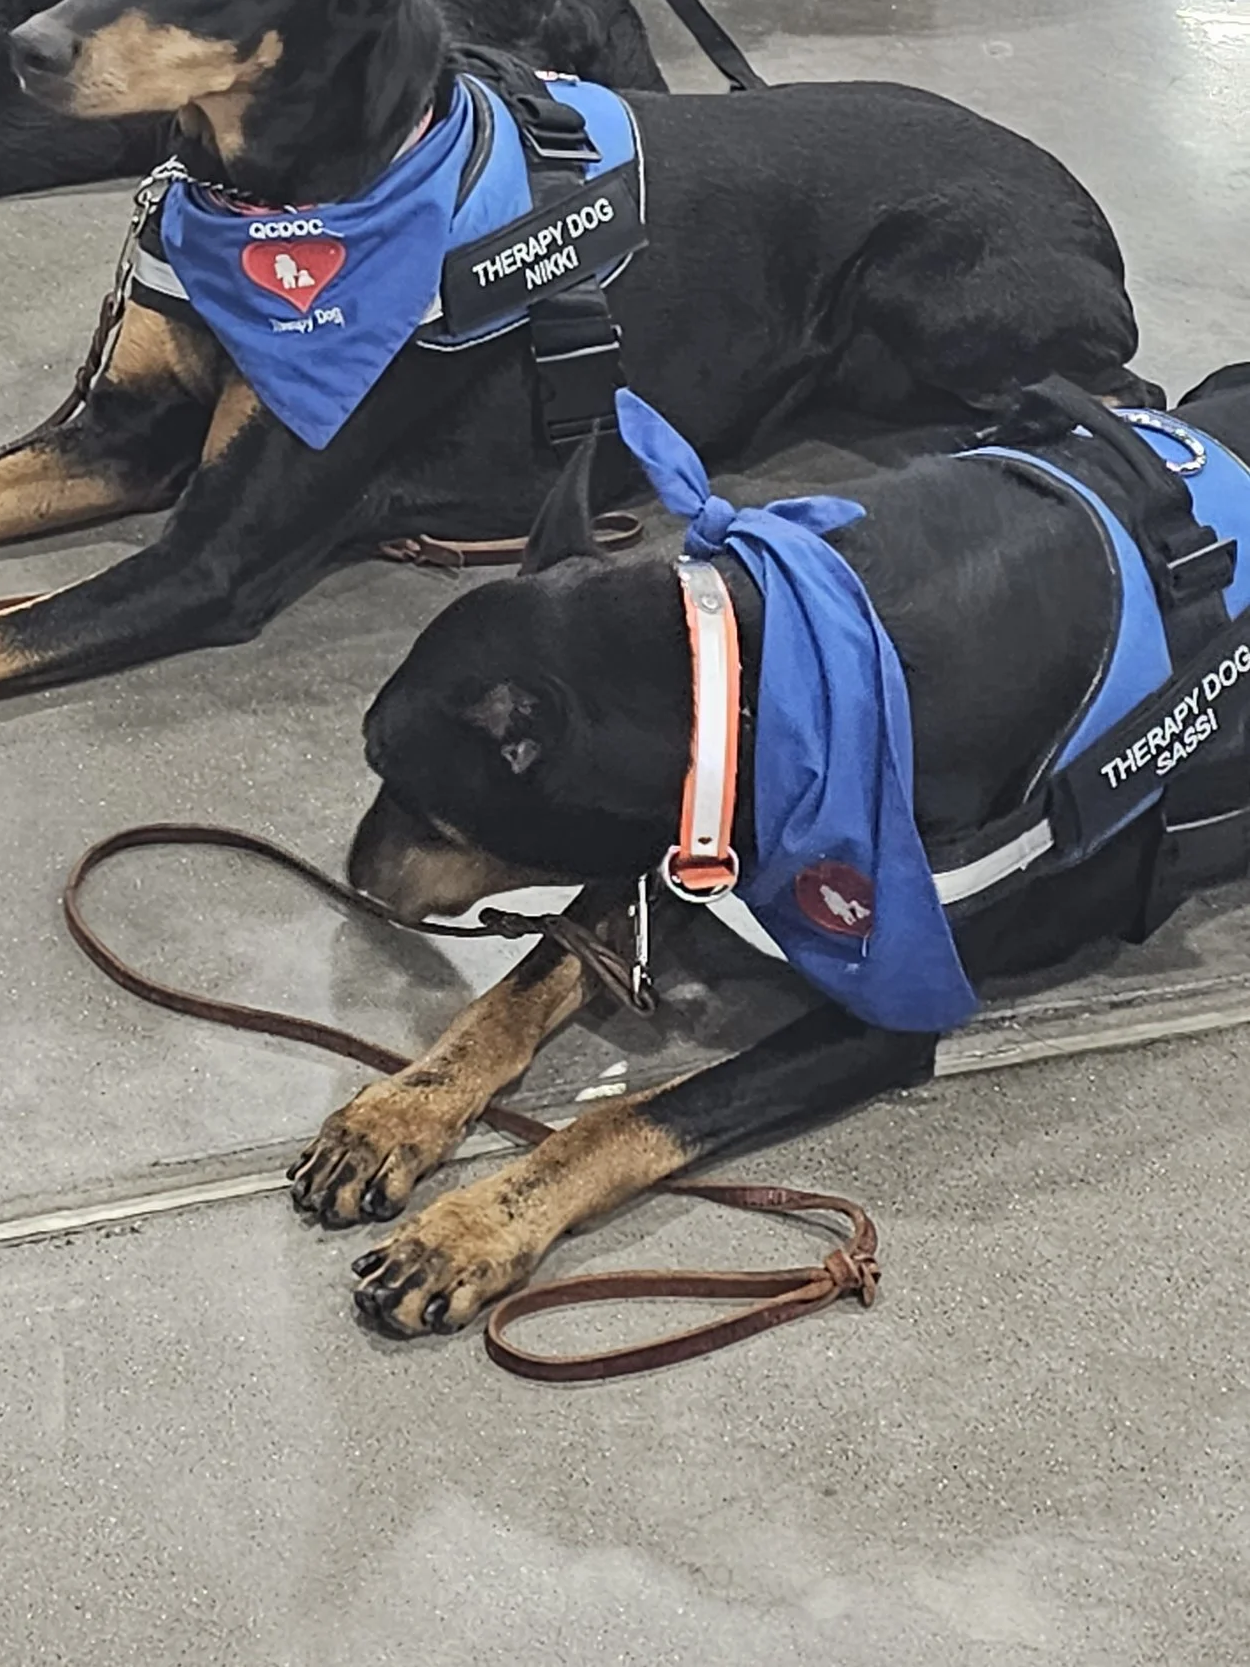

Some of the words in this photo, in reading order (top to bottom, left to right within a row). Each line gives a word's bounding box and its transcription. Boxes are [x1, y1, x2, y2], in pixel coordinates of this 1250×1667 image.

[249, 218, 324, 239] QCDOC
[472, 220, 563, 287] THERAPY
[566, 197, 614, 238] DOG
[525, 245, 580, 290] NIKKI
[314, 306, 345, 329] Dog
[1101, 687, 1200, 788] THERAPY
[1202, 644, 1250, 701] DOG
[1156, 708, 1218, 776] SASSI
